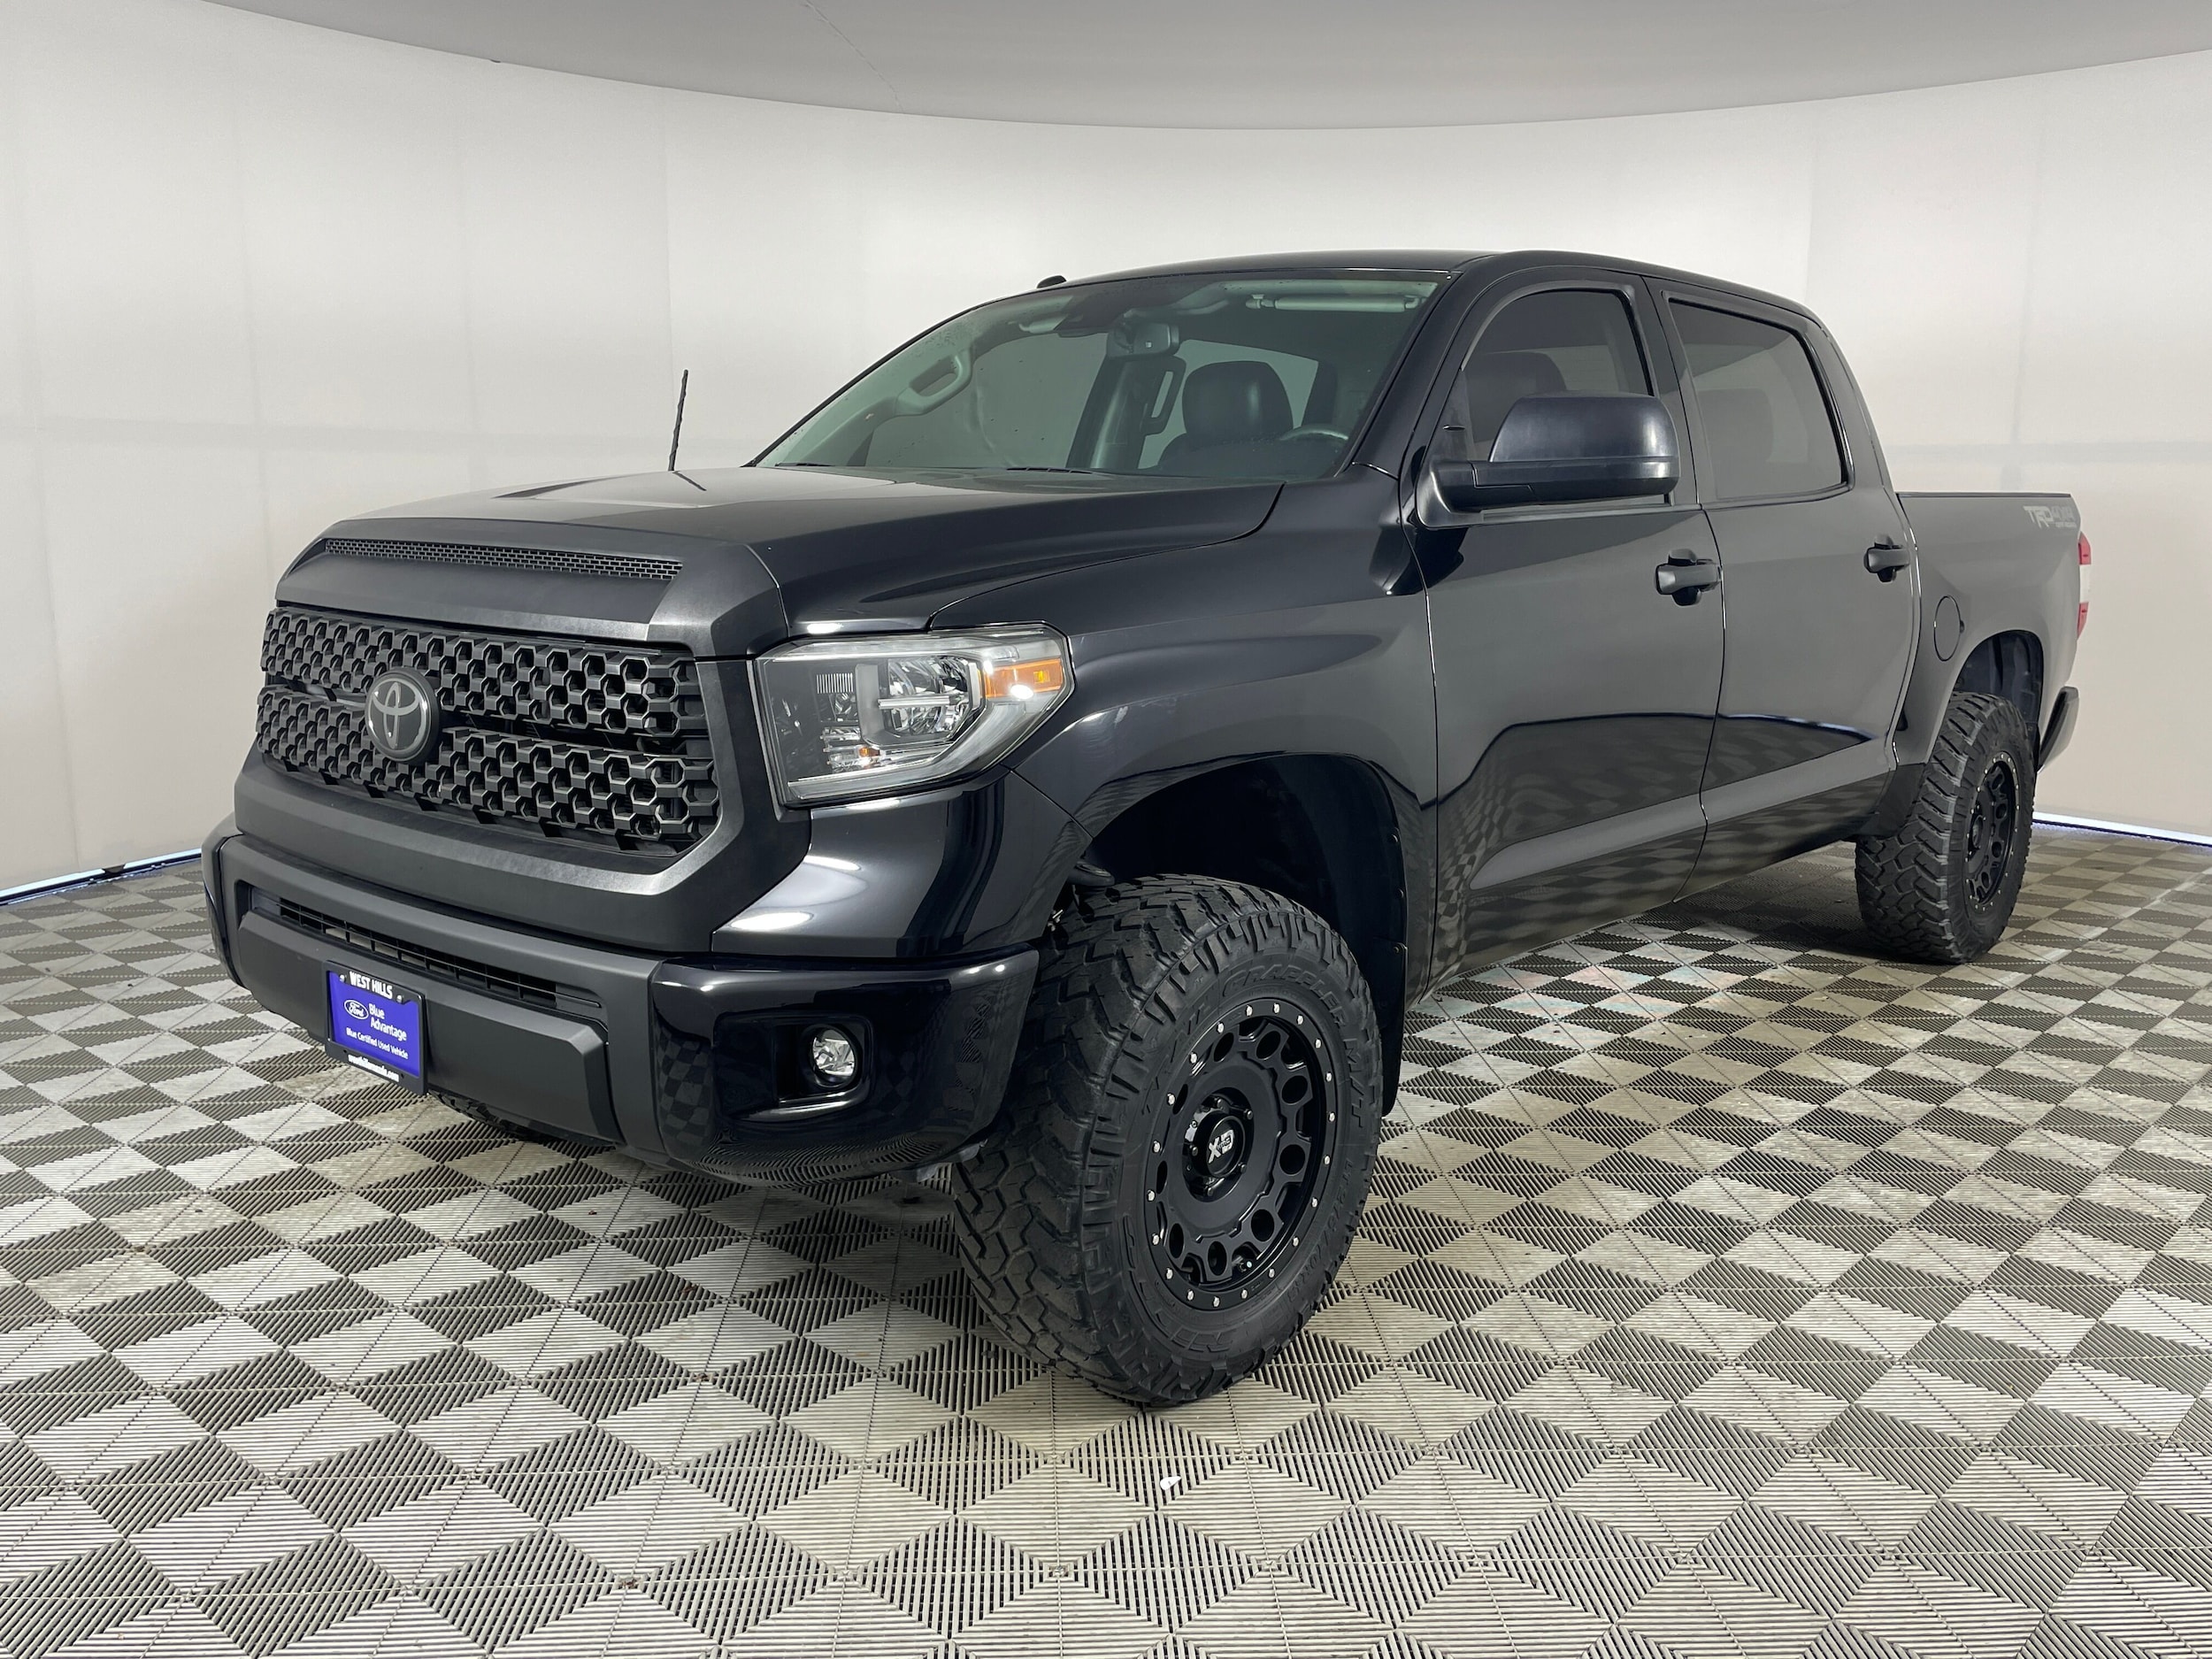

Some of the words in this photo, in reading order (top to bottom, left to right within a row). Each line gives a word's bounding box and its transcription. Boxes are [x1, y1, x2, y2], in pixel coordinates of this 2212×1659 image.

[2023, 505, 2054, 529] TRD
[349, 971, 371, 990] WEST
[372, 979, 393, 1000] HILLS
[1222, 964, 1348, 1027] GRAPPLER
[348, 1002, 365, 1018] Ford
[368, 1002, 386, 1019] Blue
[346, 1027, 357, 1039] Blue
[357, 1032, 378, 1047] Certified
[378, 1040, 390, 1053] Used
[390, 1044, 409, 1060] Vehicle
[370, 1017, 407, 1041] Advantage
[1209, 1129, 1234, 1164] XD
